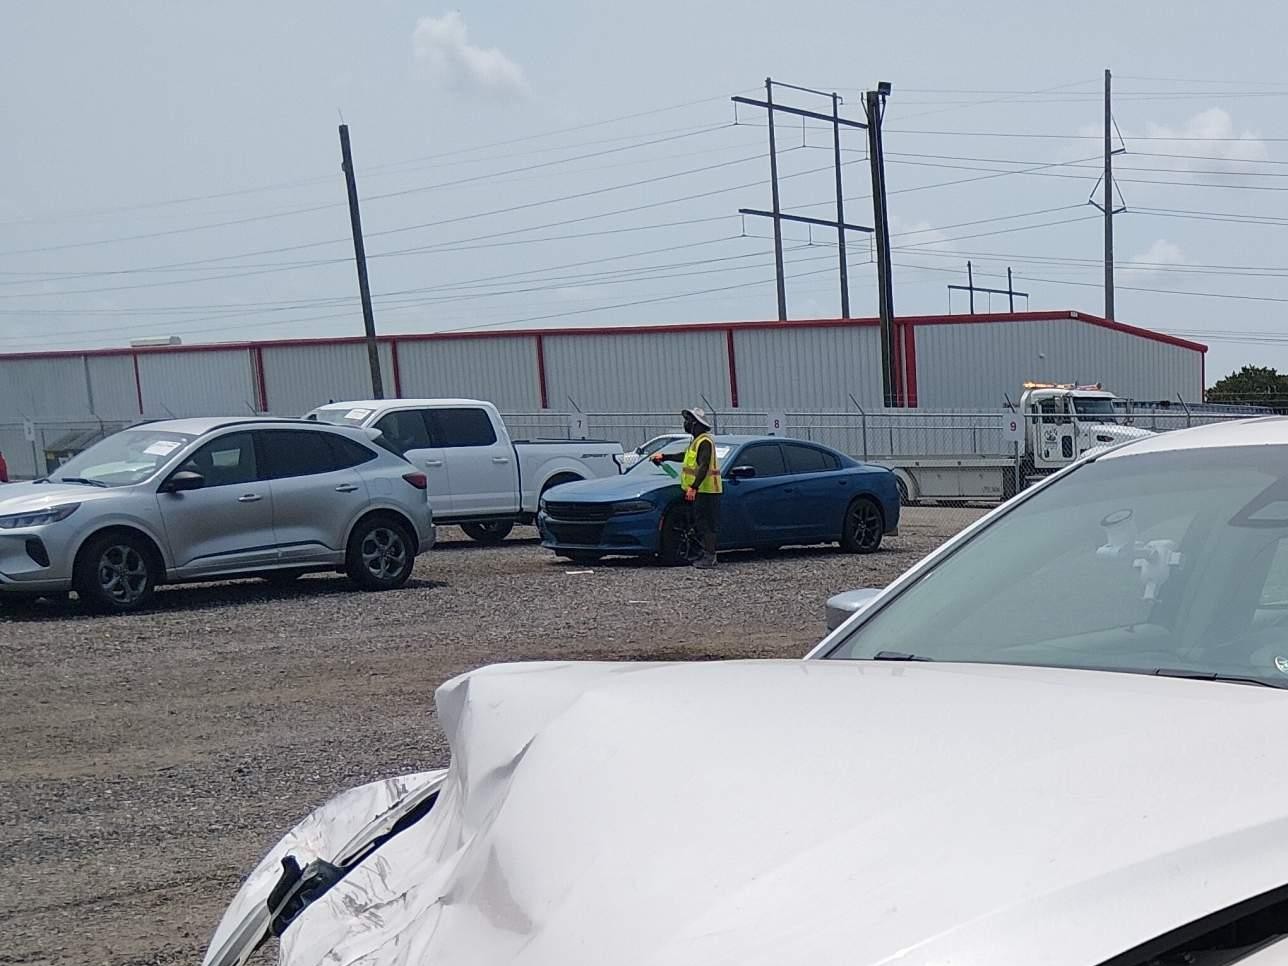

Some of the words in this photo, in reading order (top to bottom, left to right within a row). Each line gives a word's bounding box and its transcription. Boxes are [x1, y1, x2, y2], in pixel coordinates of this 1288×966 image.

[576, 419, 582, 429] 7
[774, 419, 780, 429] 8
[1009, 421, 1017, 432] 9
